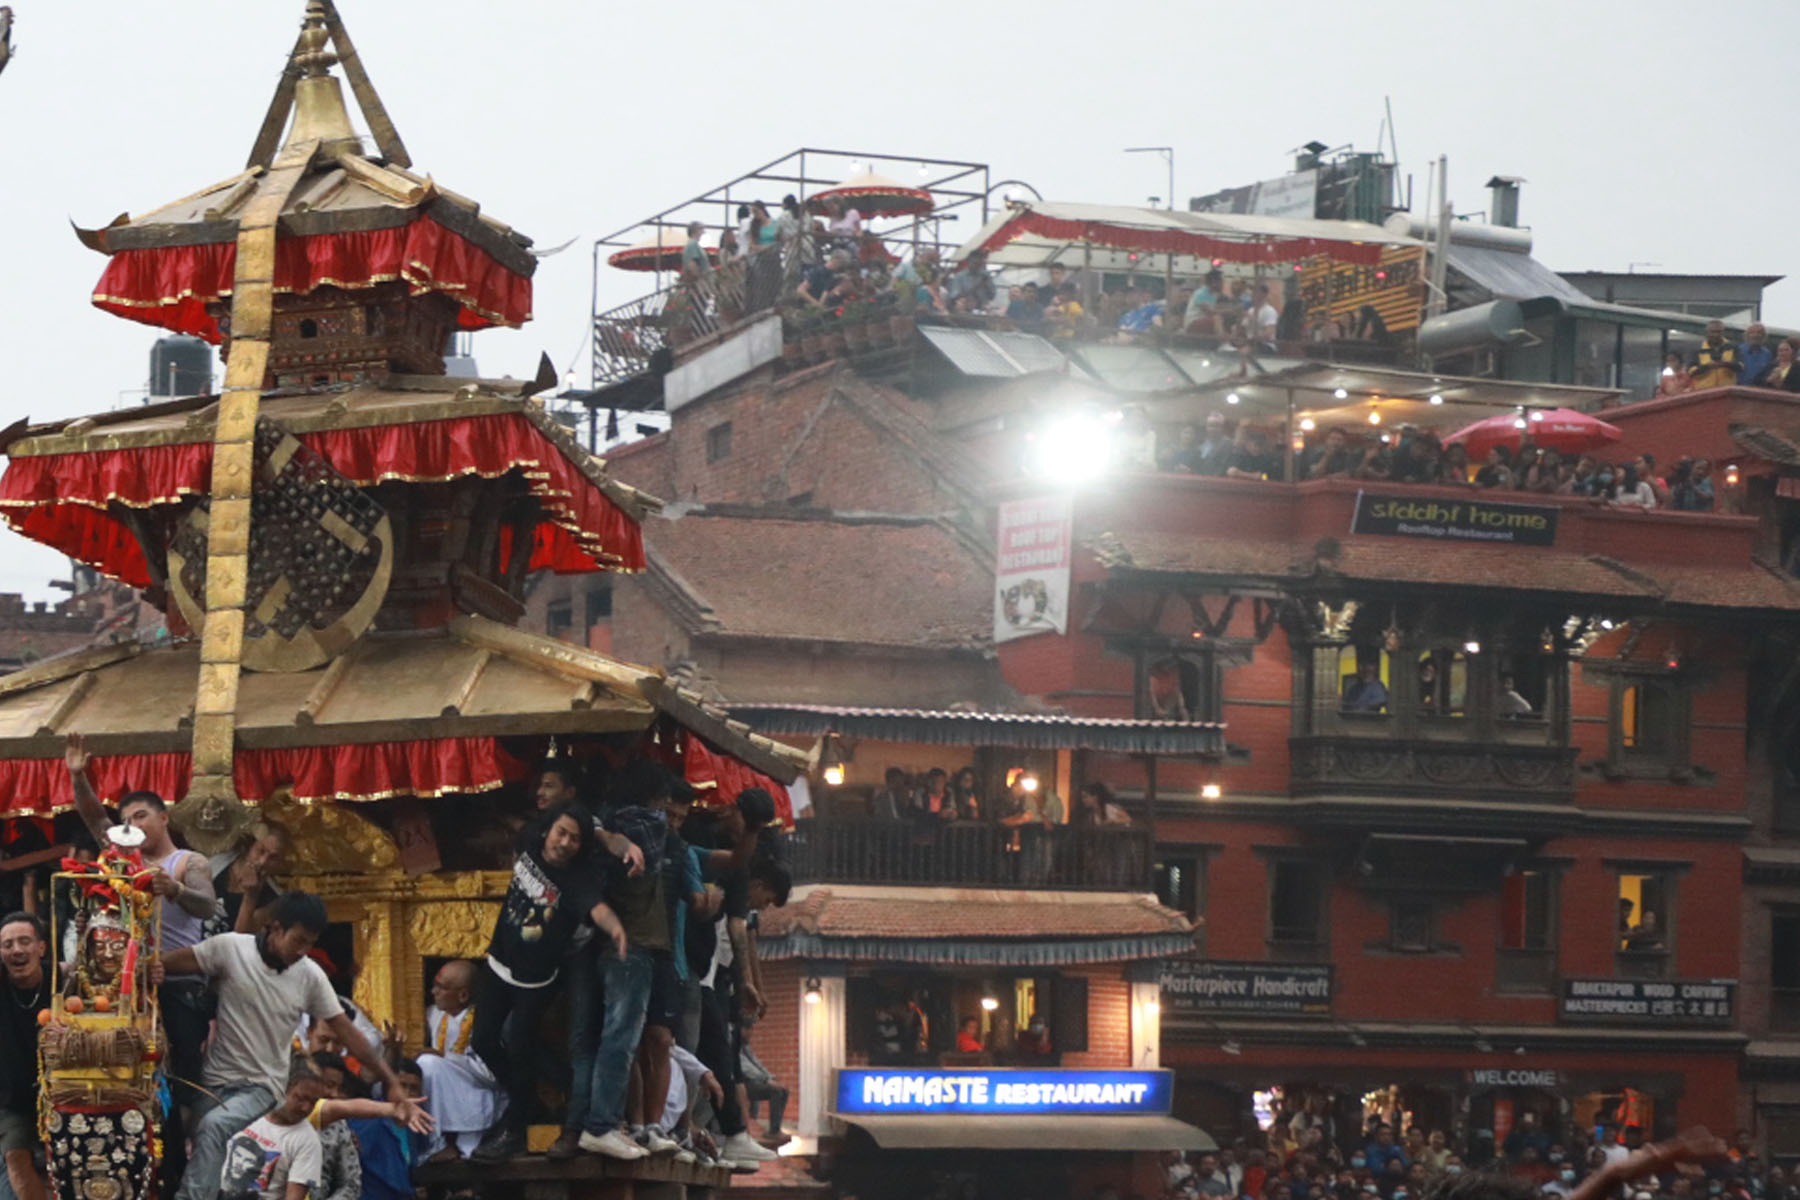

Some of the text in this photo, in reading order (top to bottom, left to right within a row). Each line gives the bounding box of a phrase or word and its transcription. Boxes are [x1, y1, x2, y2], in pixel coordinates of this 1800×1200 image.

[1469, 506, 1548, 530] home
[1449, 527, 1515, 541] Restaurant
[1159, 974, 1329, 997] Masterpiece Handicraft
[1643, 983, 1675, 998] WOOD
[1565, 1000, 1648, 1014] MASTERPIECES
[1473, 1070, 1556, 1086] WELCOME
[863, 1075, 1148, 1107] NAMASTE RESTAURANT
